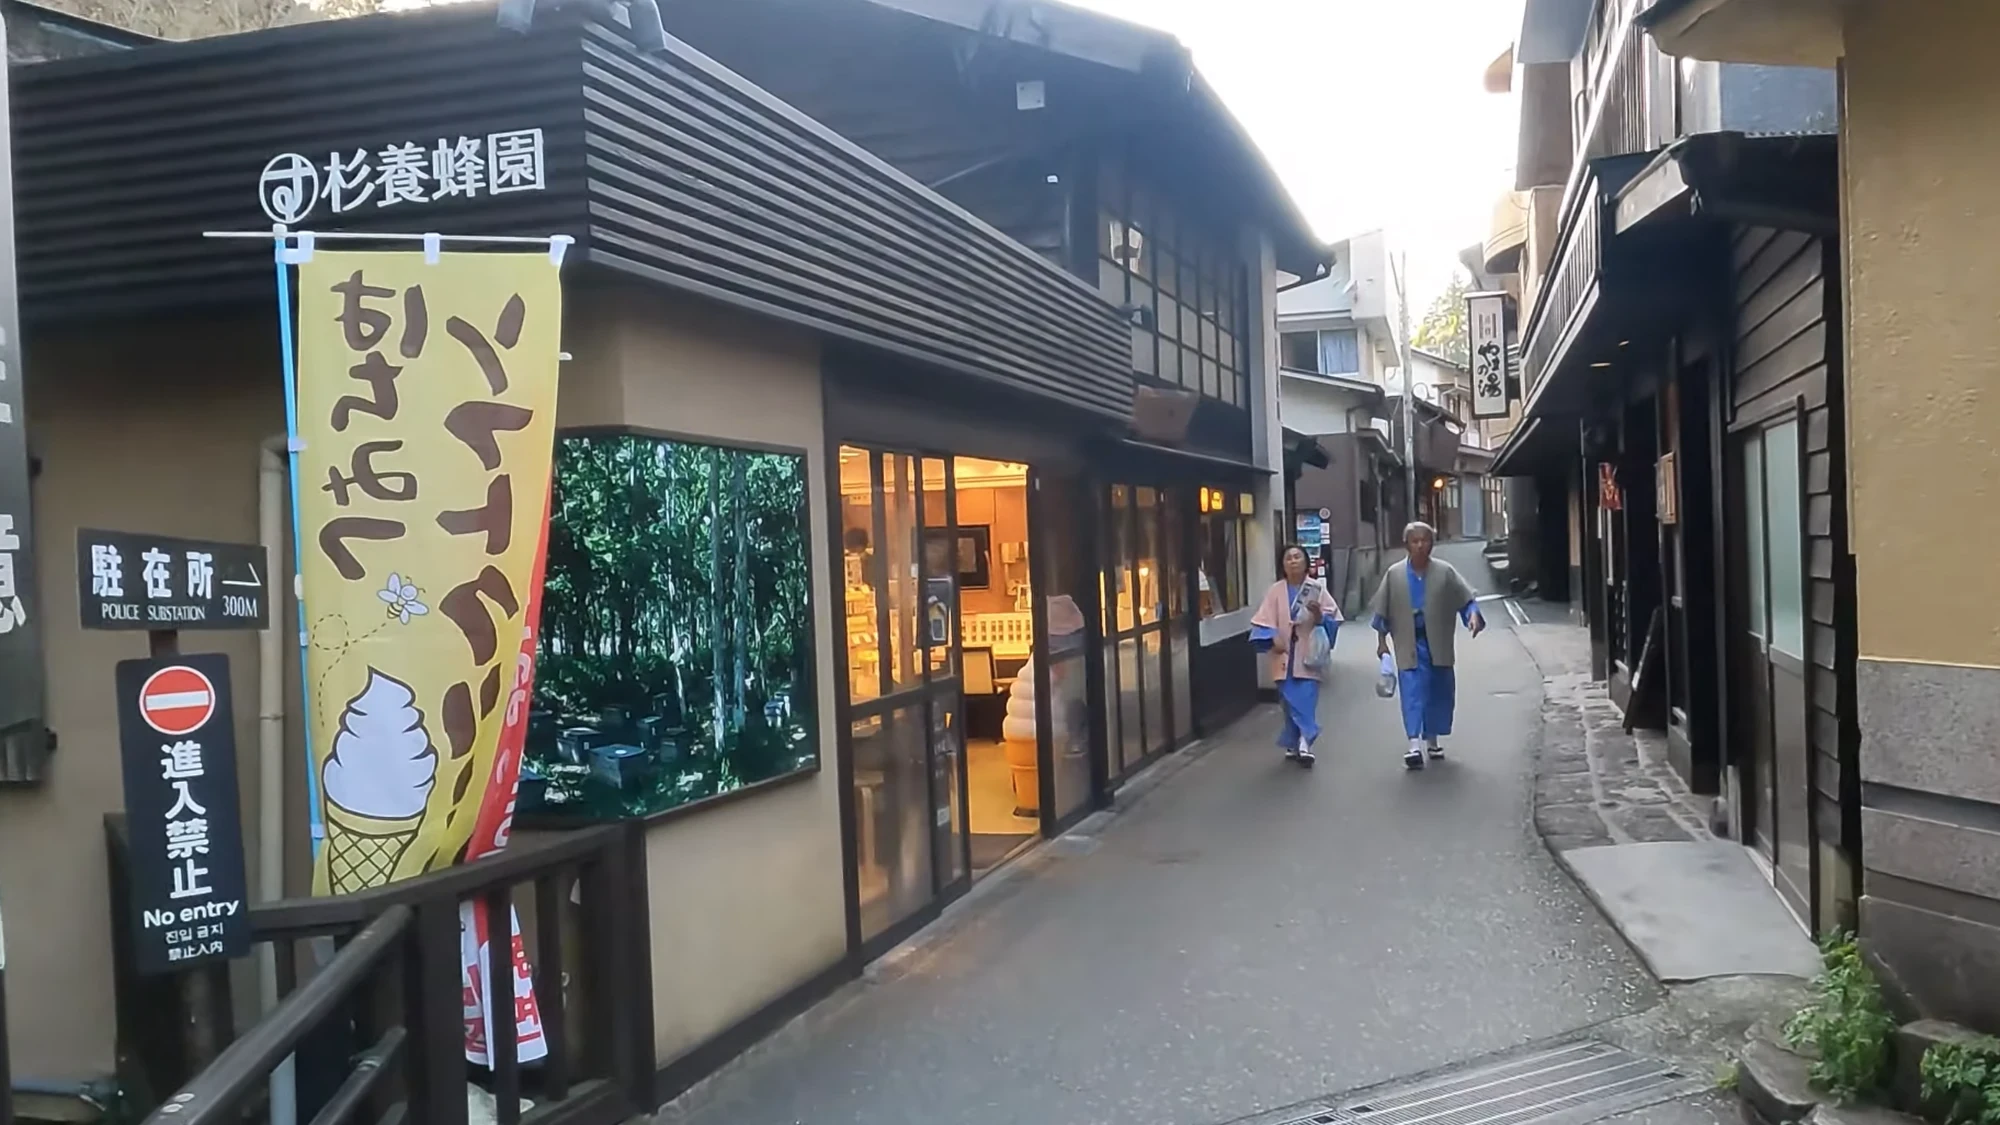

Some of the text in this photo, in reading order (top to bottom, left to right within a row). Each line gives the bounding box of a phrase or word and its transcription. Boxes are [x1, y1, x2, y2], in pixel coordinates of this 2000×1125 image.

[321, 128, 546, 213] 杉養蜂園
[91, 544, 214, 600] 駐在所
[101, 602, 206, 621] POLICE SUBSTATION
[222, 595, 258, 617] 300M
[160, 740, 213, 899] 進入禁止
[143, 899, 240, 928] No entry
[165, 922, 224, 944] 진입 금지
